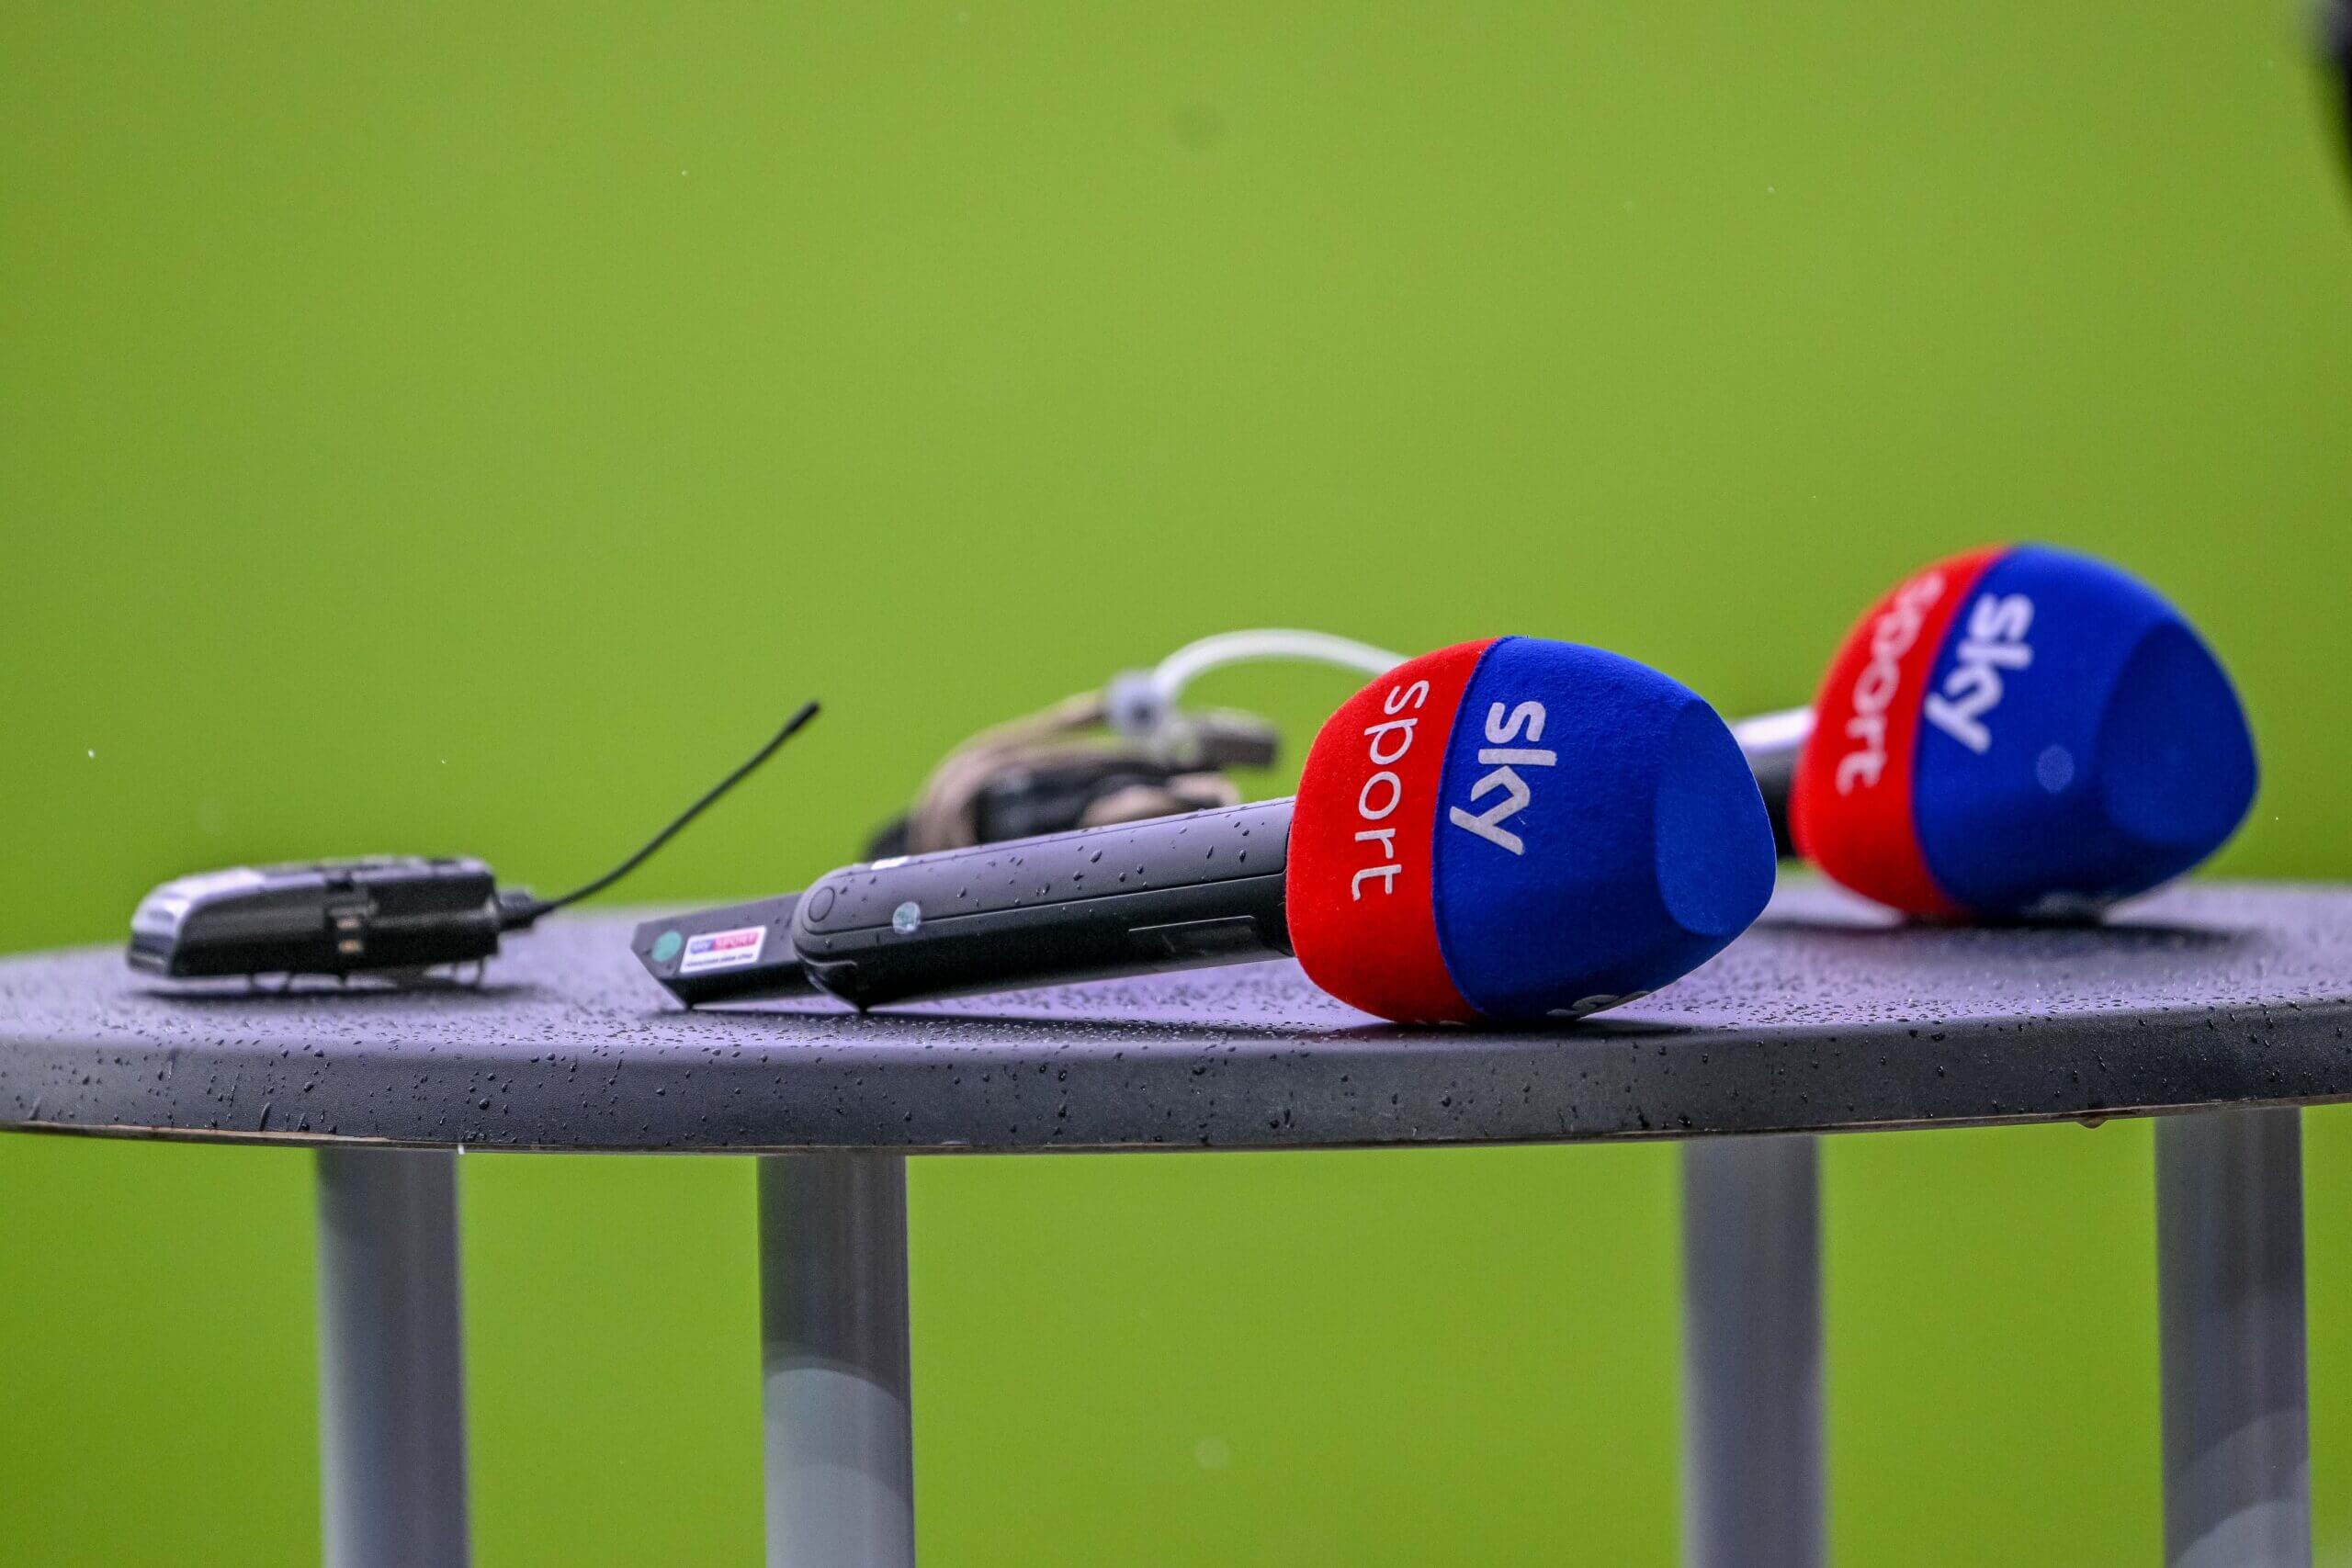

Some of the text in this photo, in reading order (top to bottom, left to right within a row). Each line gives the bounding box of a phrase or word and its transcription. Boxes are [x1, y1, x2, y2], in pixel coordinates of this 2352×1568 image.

[1836, 573, 1945, 795] sport
[1925, 593, 2034, 753] sky
[1351, 680, 1430, 901] sport
[1450, 700, 1557, 856] sky
